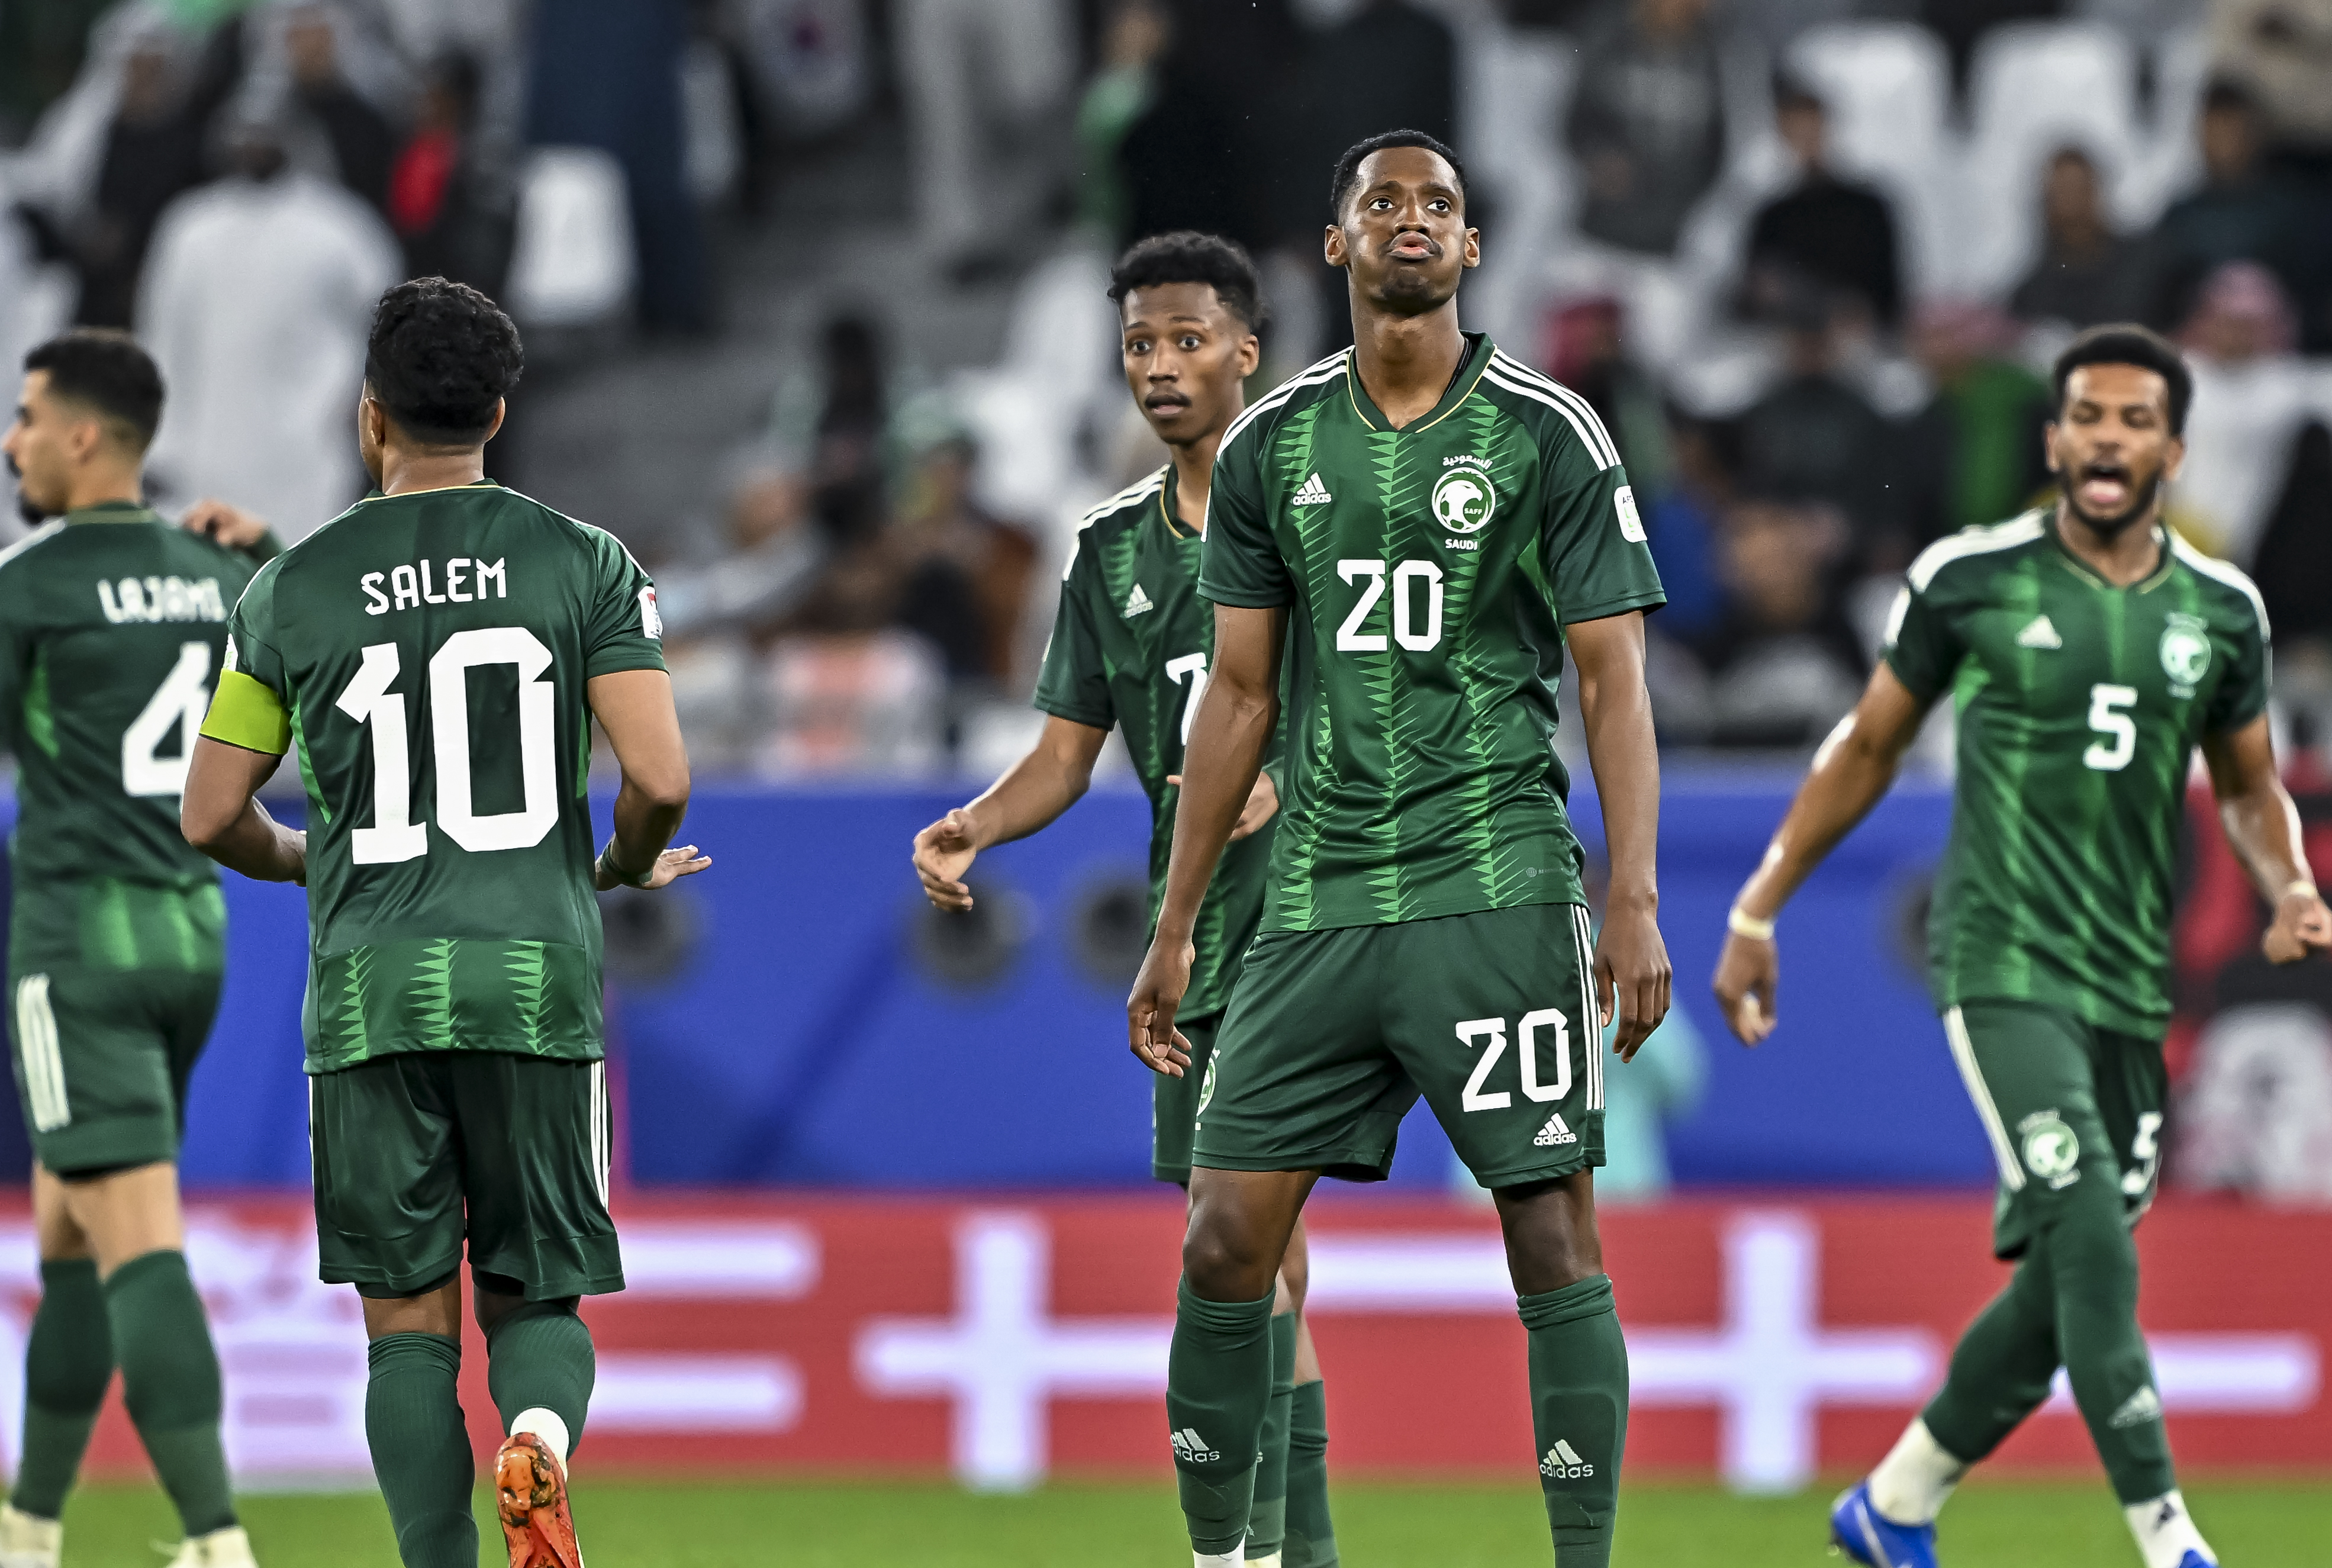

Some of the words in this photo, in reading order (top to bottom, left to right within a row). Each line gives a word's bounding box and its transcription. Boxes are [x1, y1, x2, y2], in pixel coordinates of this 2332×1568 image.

[1292, 492, 1332, 505] adidas
[1445, 538, 1478, 550] SAUDI
[360, 557, 507, 616] SALEM
[1336, 559, 1444, 652] 20
[335, 627, 559, 865] 10
[2083, 682, 2138, 771] 5
[1455, 1008, 1572, 1112] 20
[1533, 1132, 1577, 1146] adidas
[1539, 1463, 1594, 1479] adidas
